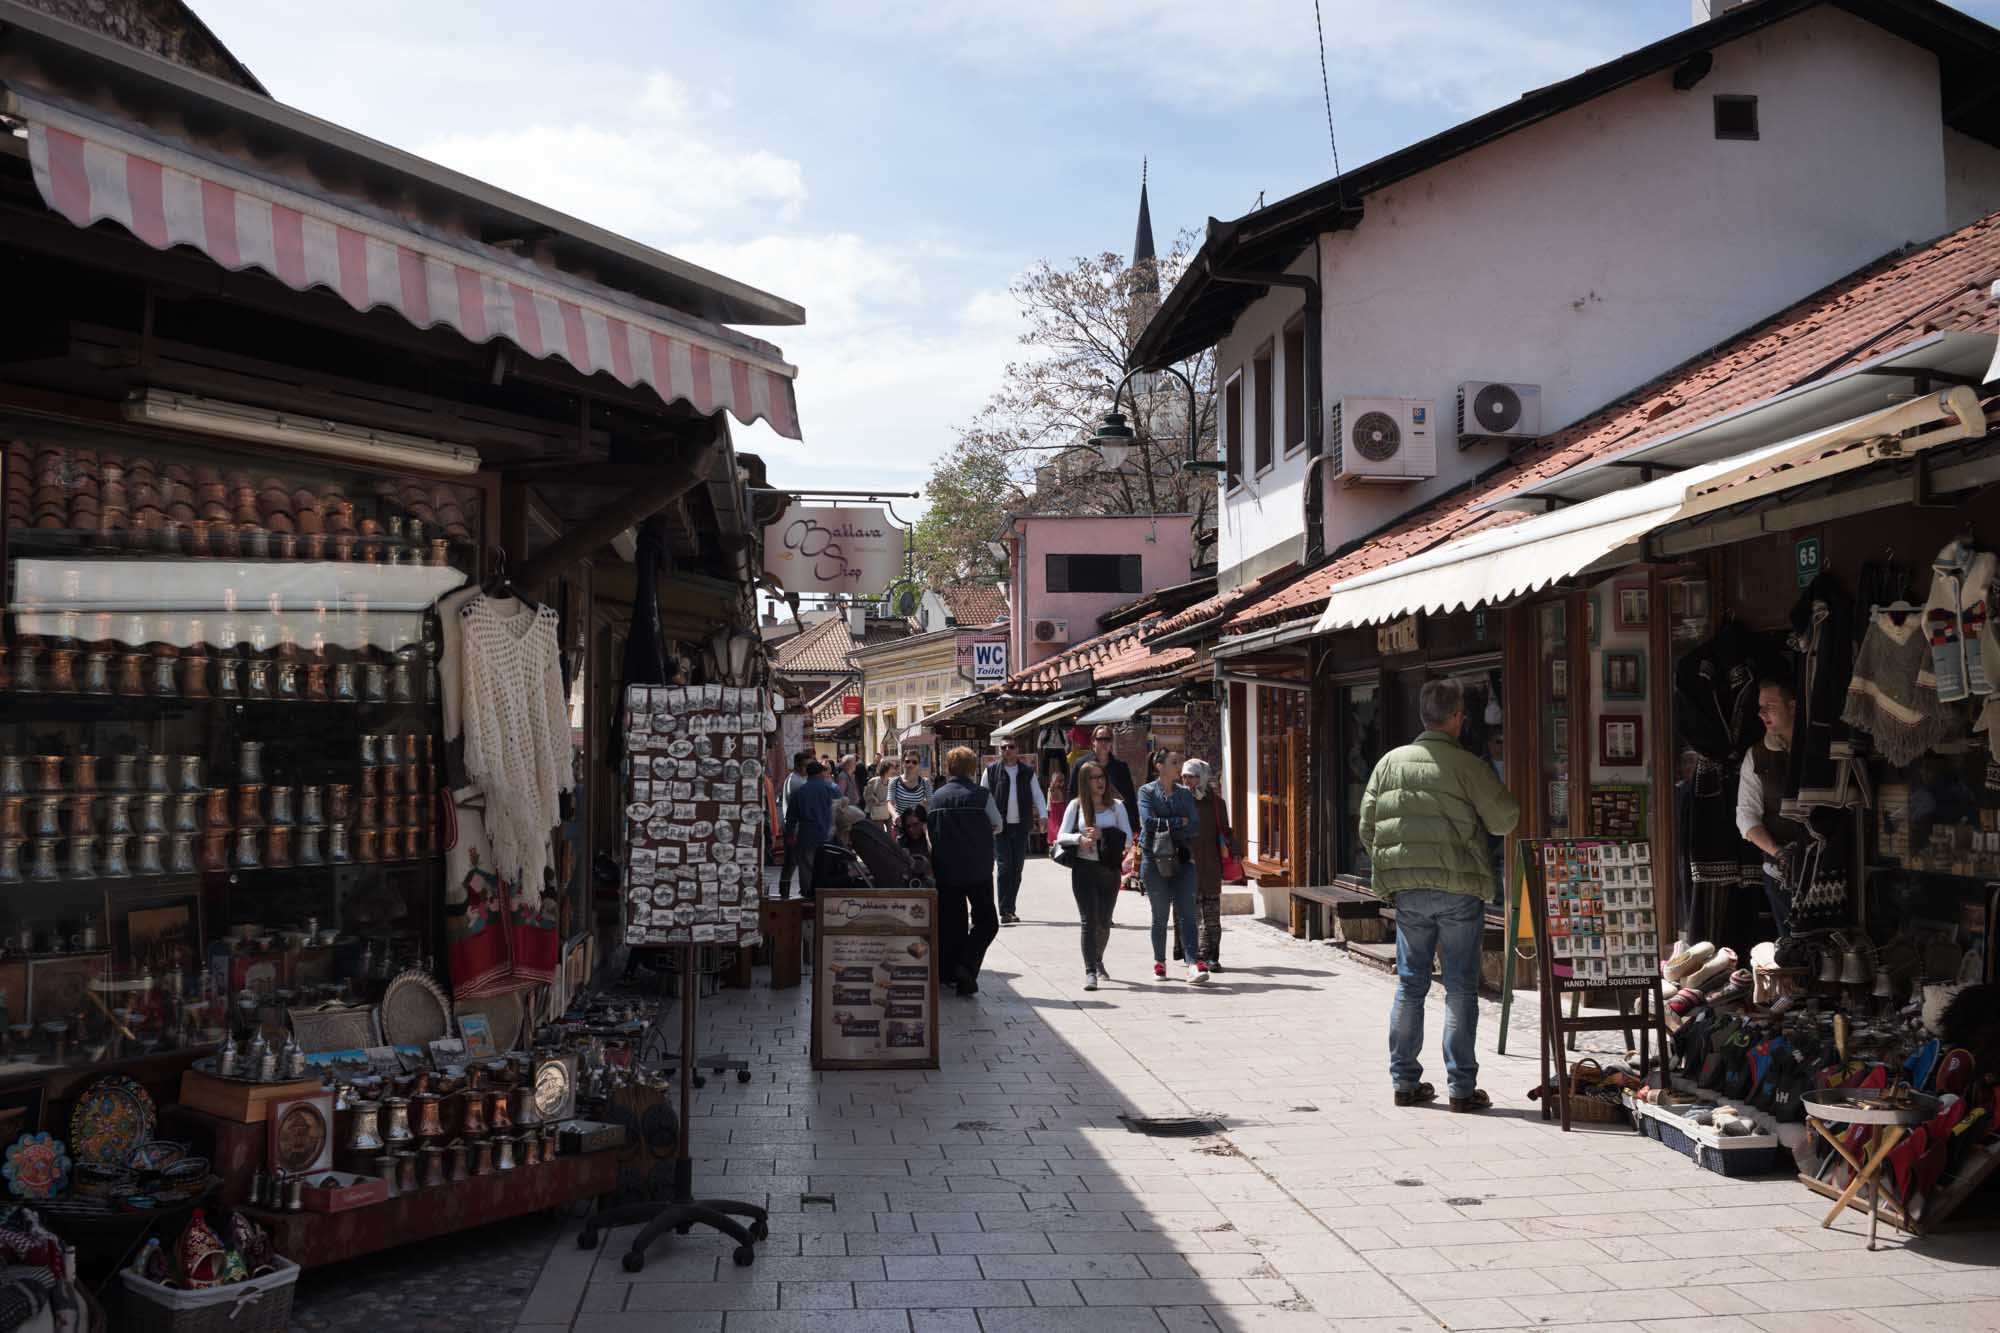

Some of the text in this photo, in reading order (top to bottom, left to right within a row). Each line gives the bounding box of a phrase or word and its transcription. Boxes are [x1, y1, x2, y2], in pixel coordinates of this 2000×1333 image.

[784, 519, 884, 557] Baklava
[814, 544, 863, 582] Shop
[1800, 546, 1816, 566] 65
[976, 646, 1003, 665] WC
[976, 667, 1004, 675] Toilet
[1564, 977, 1651, 988] HAND MADE SOUVENIRS
